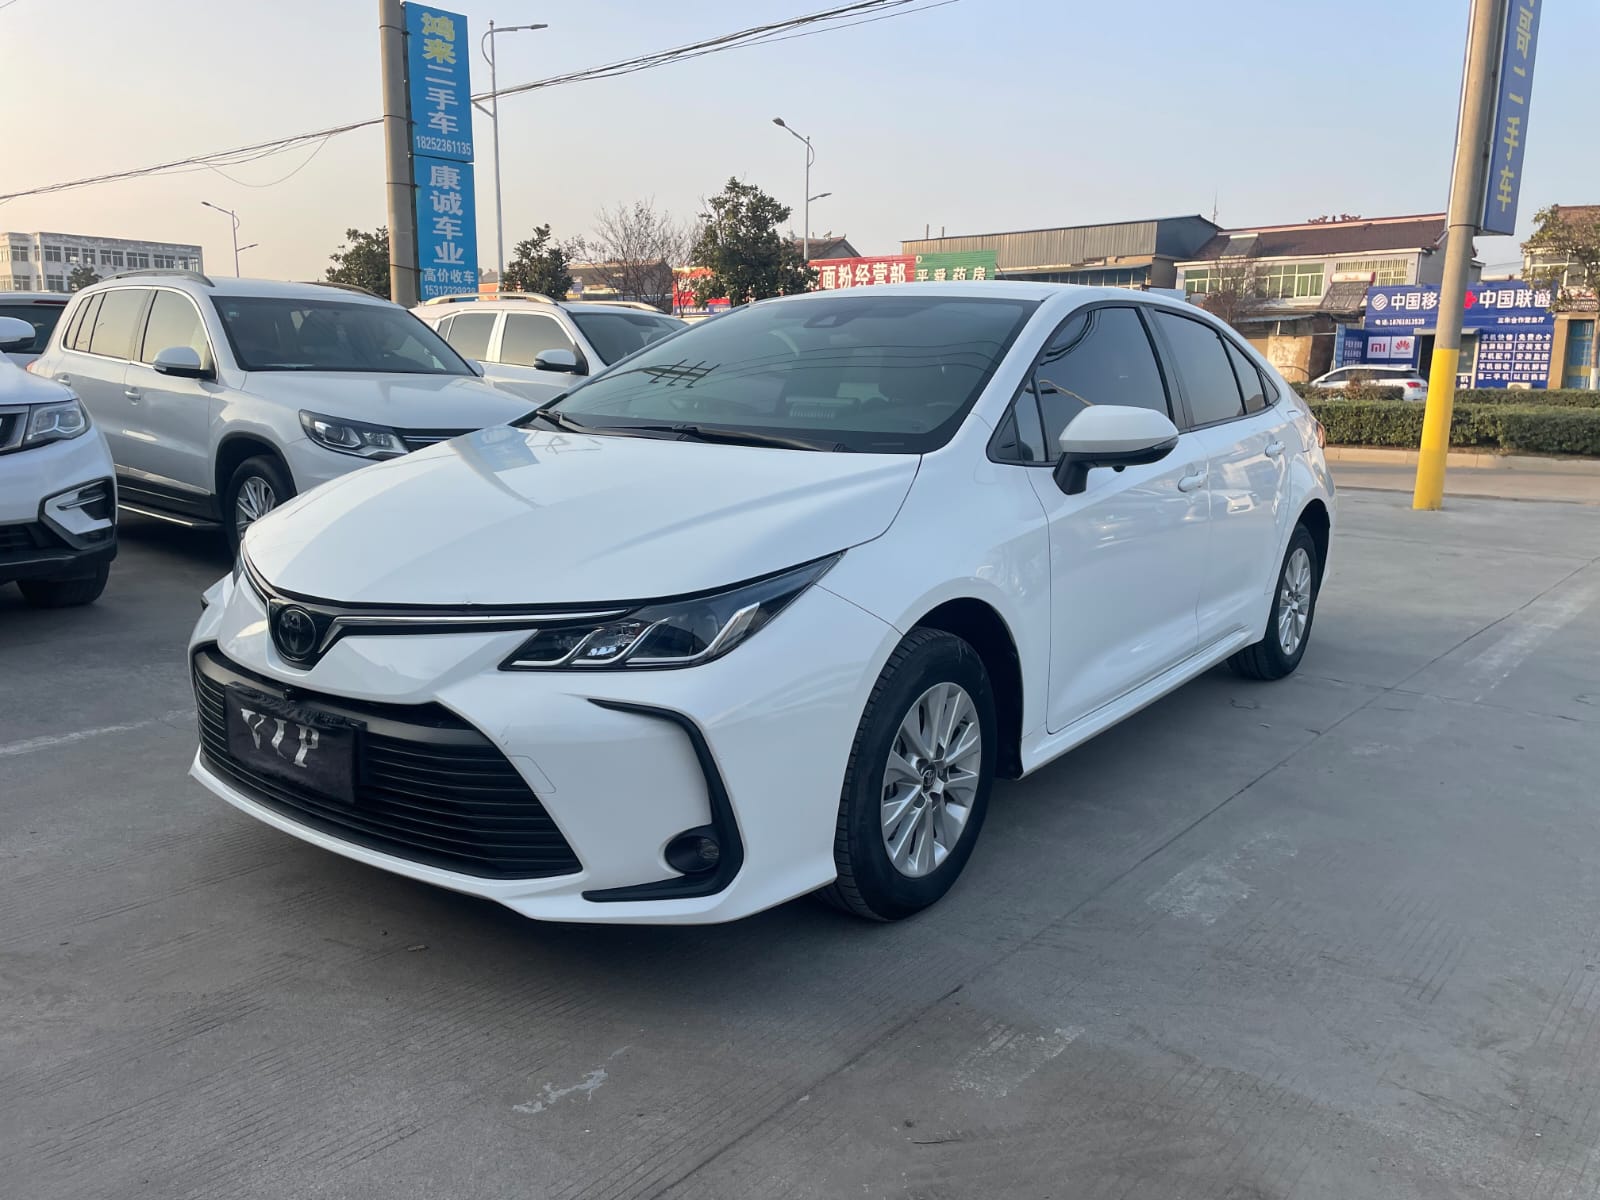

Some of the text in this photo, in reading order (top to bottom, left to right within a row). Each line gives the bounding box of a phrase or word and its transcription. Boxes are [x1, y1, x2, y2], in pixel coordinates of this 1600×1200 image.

[421, 12, 459, 135] 鸿来二手车
[1496, 0, 1535, 213] 哥二手车
[415, 135, 472, 156] 18252361135
[429, 165, 465, 265] 康诚车业
[423, 267, 475, 285] 高价收车
[1391, 291, 1441, 311] 中国移
[1479, 289, 1551, 309] 中国联通
[240, 708, 320, 768] VIP
